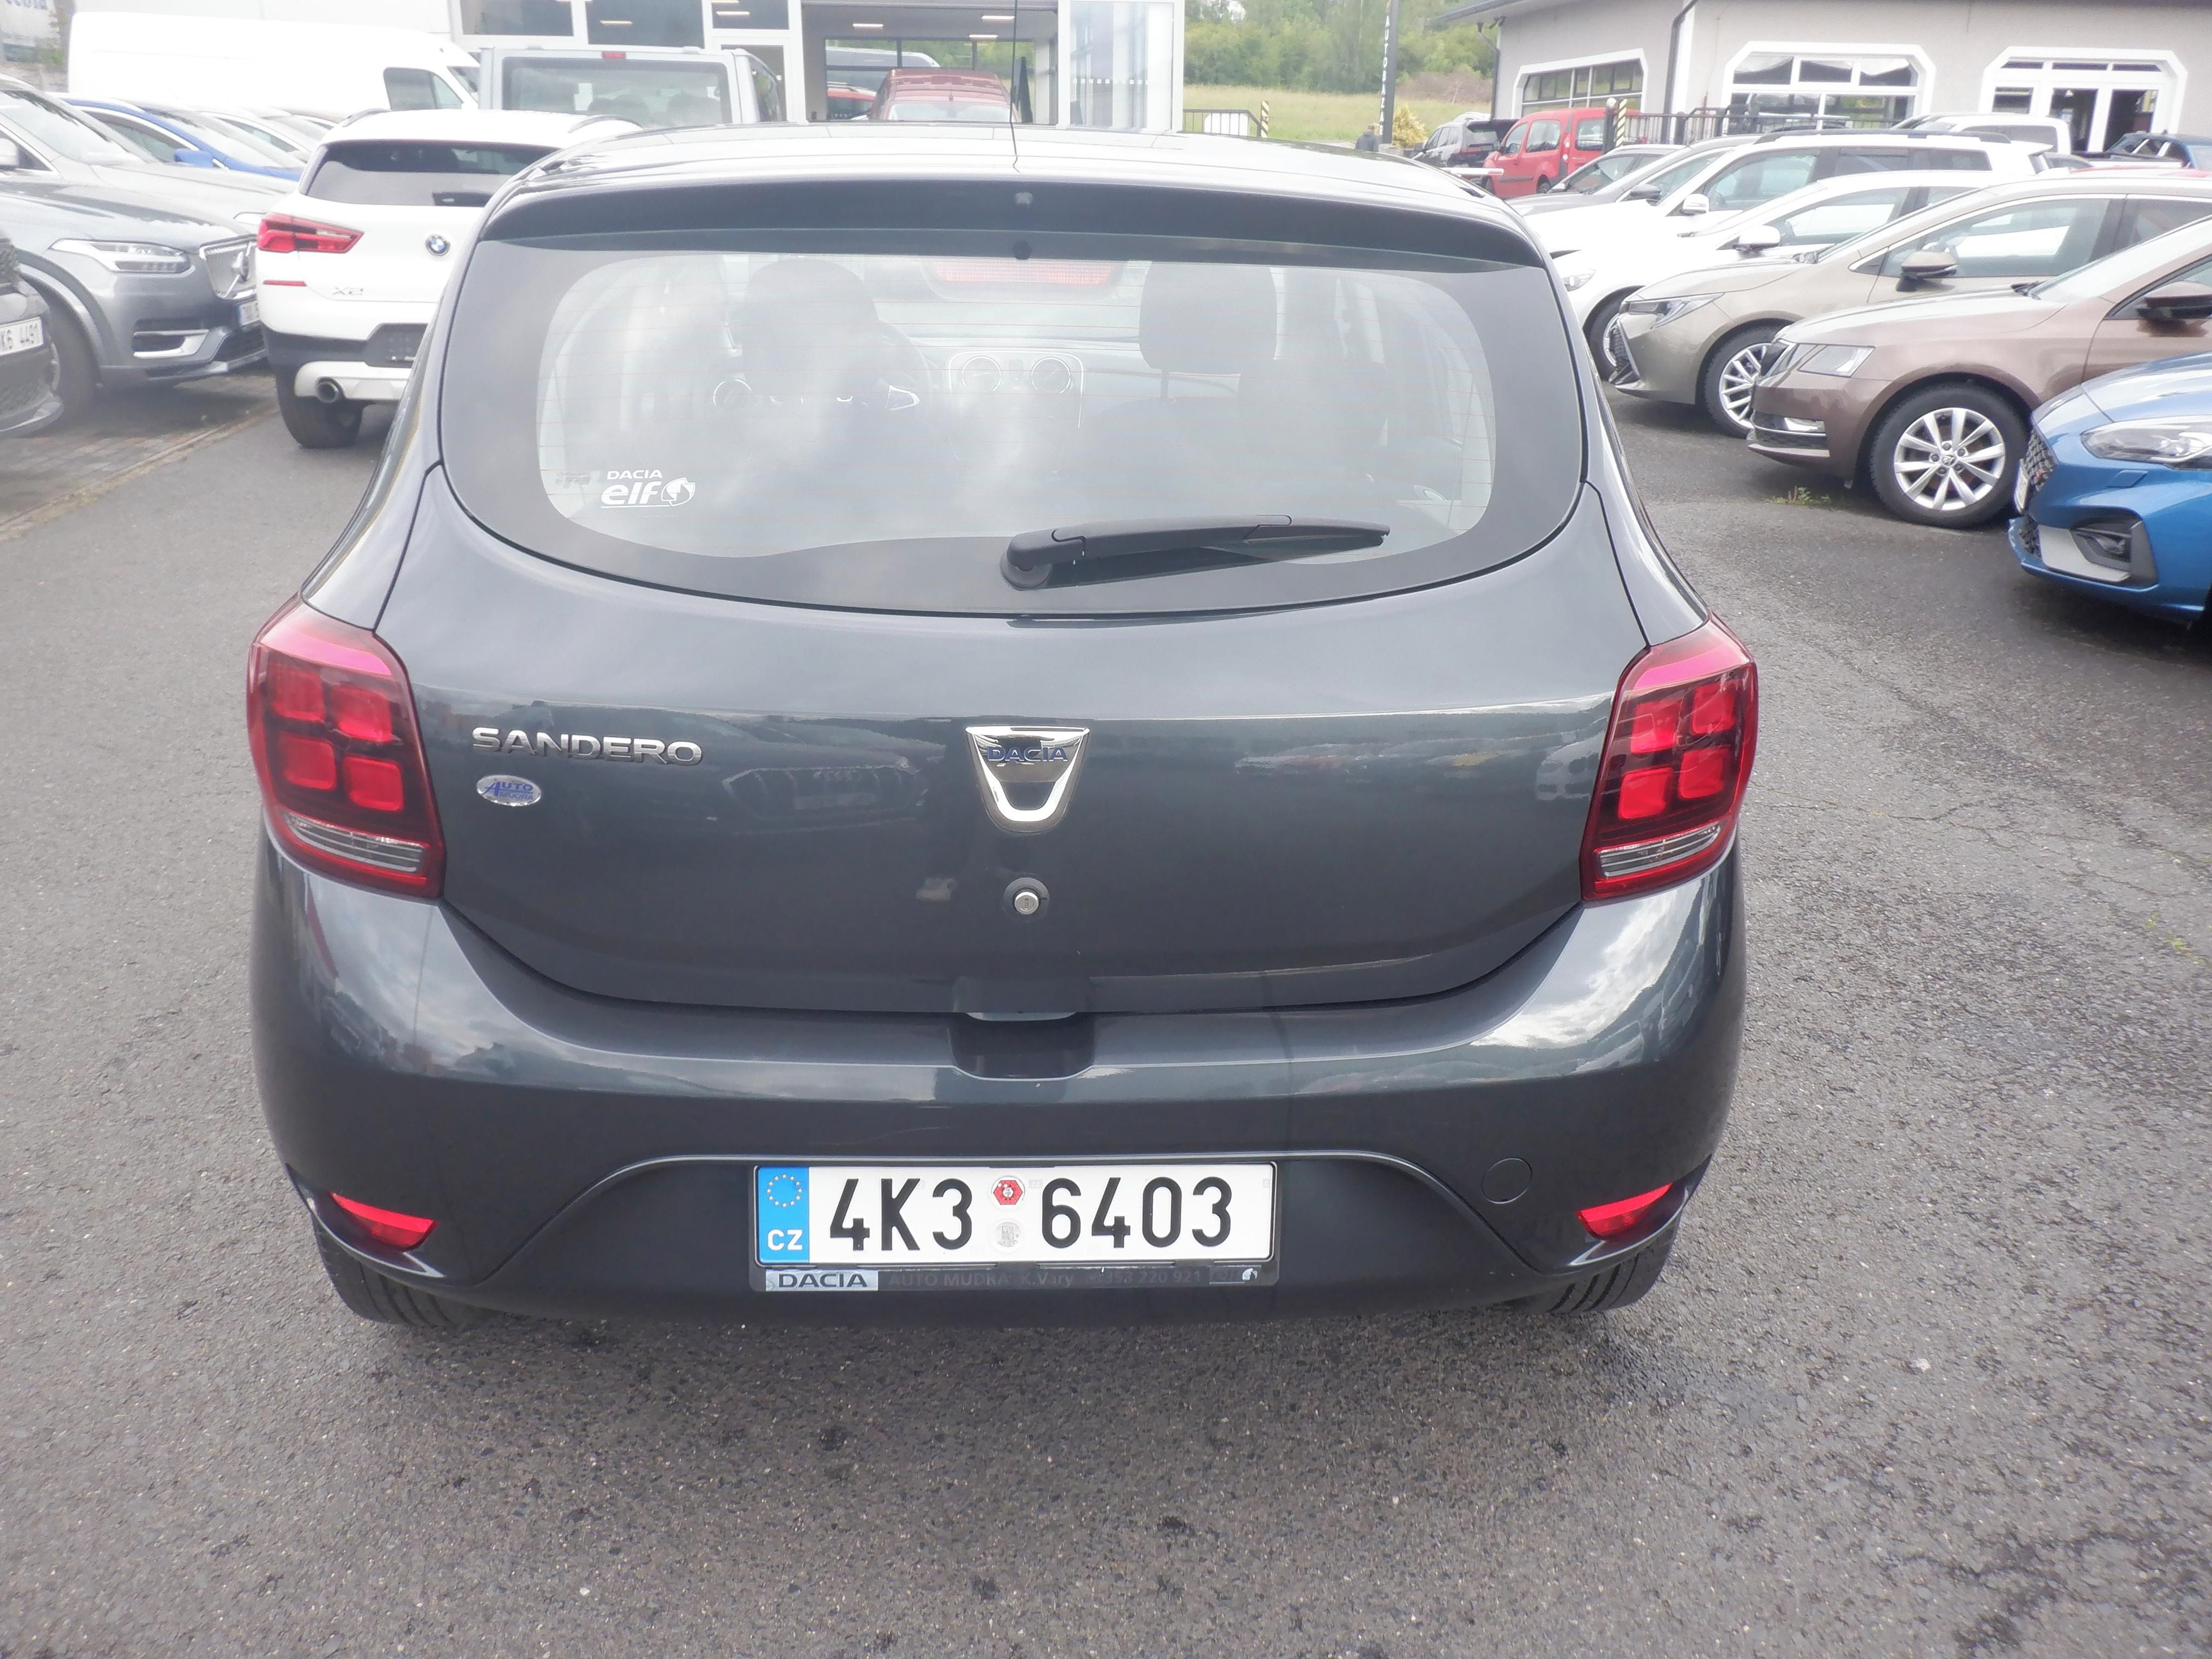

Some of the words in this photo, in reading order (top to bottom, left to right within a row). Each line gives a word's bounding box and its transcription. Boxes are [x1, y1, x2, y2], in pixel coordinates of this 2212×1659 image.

[1379, 15, 1390, 136] AUTOBAZAR
[607, 469, 662, 480] DACIA
[601, 481, 662, 505] elf
[472, 726, 702, 765] SANDERO
[987, 746, 1068, 761] DACIA
[483, 781, 534, 797] AUTO
[830, 1178, 973, 1251] 4K3
[1042, 1176, 1232, 1249] 6403
[767, 1229, 803, 1251] CZ
[778, 1273, 868, 1288] DACIA
